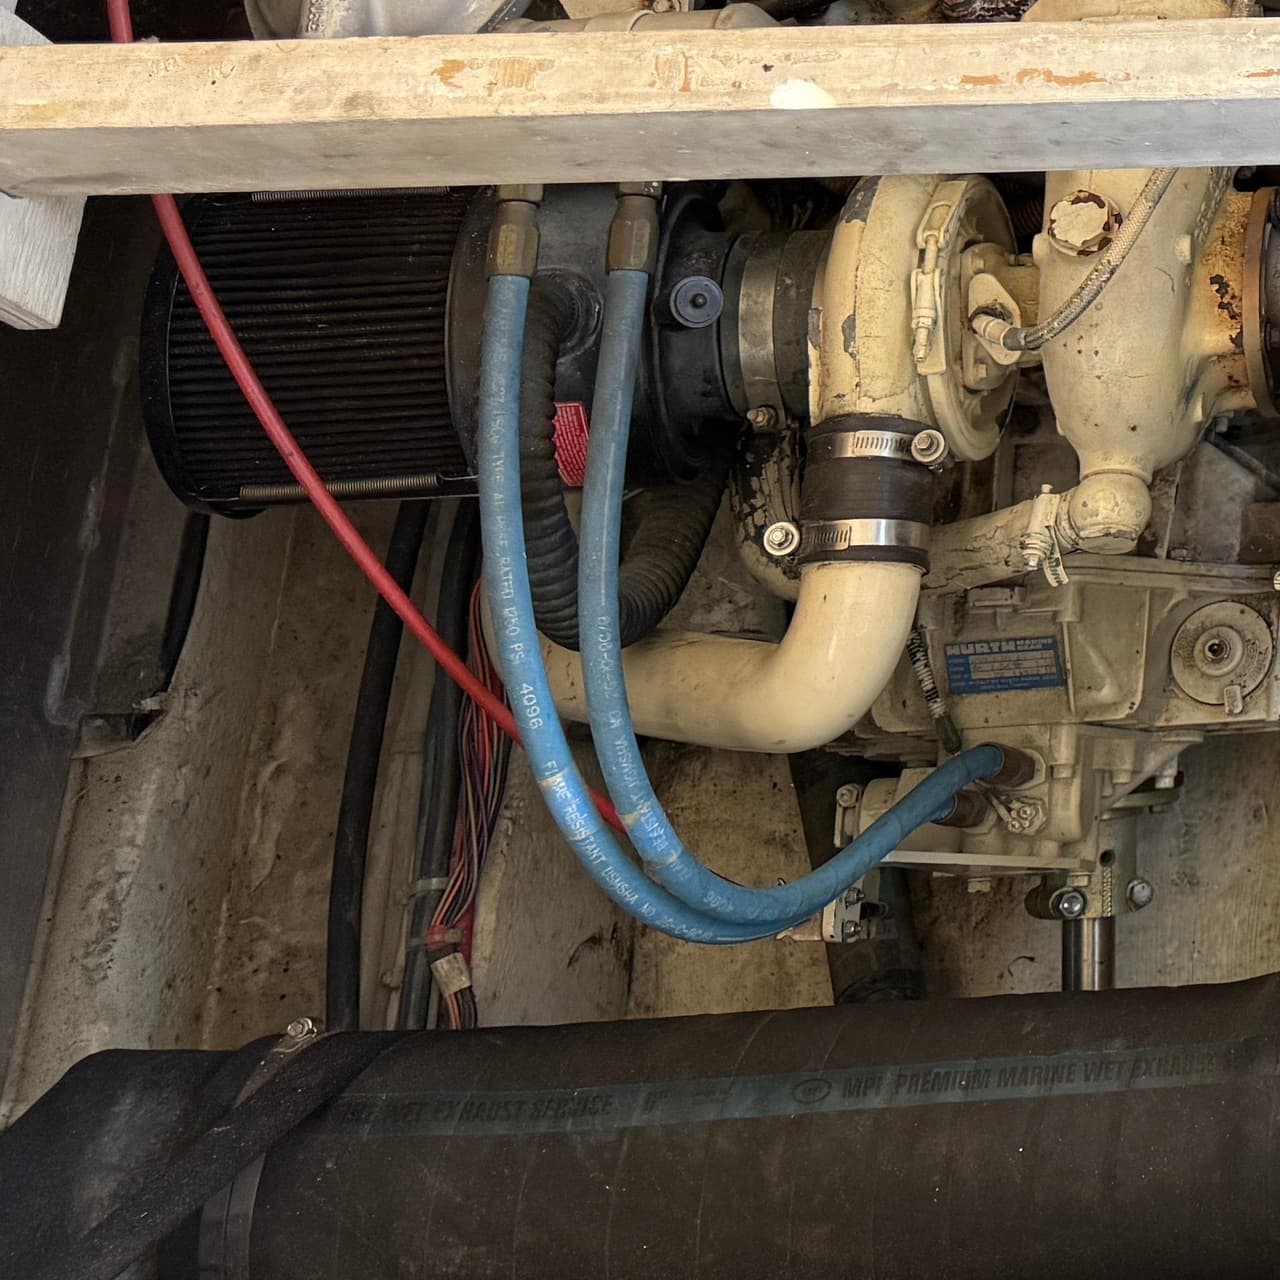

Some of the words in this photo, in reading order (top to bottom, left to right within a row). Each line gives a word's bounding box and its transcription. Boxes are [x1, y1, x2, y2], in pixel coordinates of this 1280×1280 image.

[497, 557, 515, 599] RATED
[945, 640, 1016, 656] HURTH
[842, 1074, 883, 1099] MPI
[894, 1067, 991, 1095] PREMIUM
[996, 1062, 1076, 1089] MARINE
[1083, 1058, 1128, 1084] WET
[431, 1097, 526, 1124] EXHAUST
[529, 1092, 614, 1122] SERVICE
